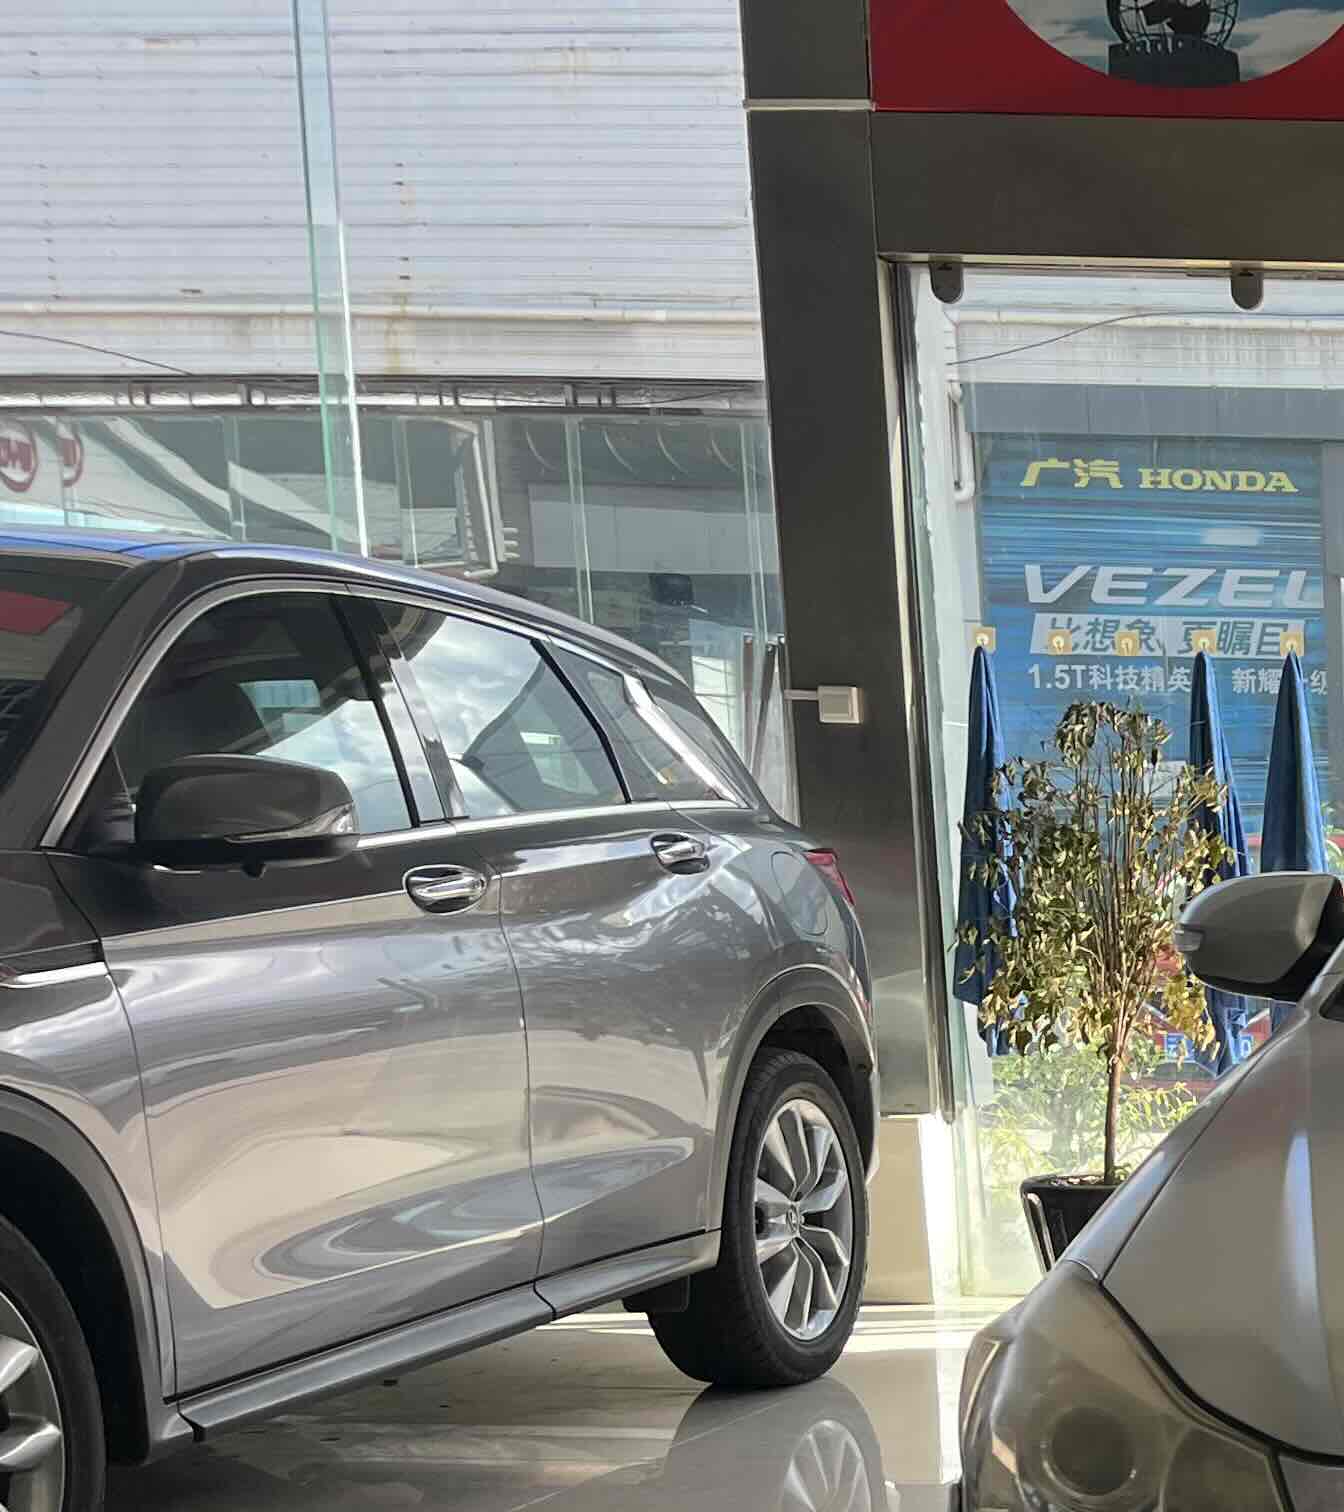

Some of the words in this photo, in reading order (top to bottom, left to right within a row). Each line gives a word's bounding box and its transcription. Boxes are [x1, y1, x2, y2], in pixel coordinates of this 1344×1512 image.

[1020, 457, 1124, 488] 广汽
[1138, 467, 1299, 493] HONDA
[1024, 564, 1325, 609] VEZEL
